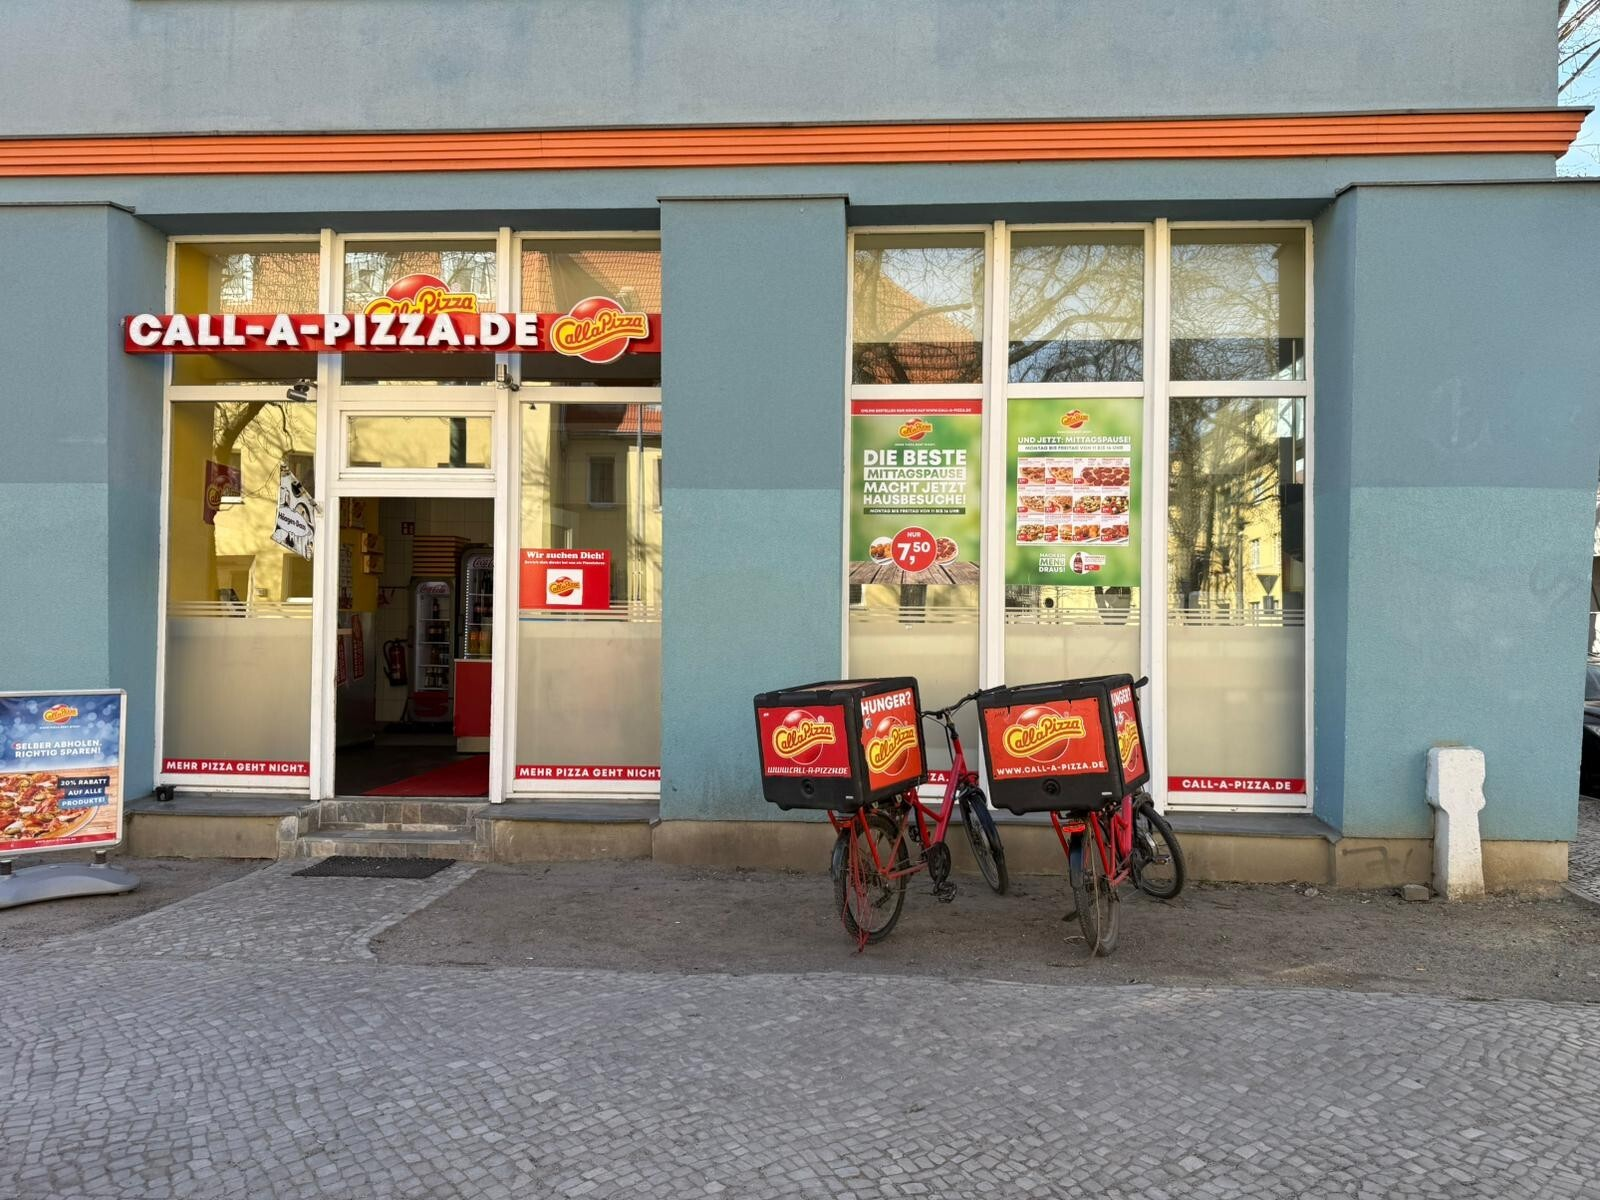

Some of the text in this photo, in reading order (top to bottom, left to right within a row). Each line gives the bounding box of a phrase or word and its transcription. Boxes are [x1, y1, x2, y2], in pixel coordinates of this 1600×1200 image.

[419, 289, 474, 315] Pizza
[129, 313, 539, 348] CALL-A-PIZZA.DE
[556, 321, 591, 351] Call
[598, 311, 643, 334] Pizza
[1065, 436, 1131, 444] MITTAGSPAUSE!
[864, 449, 967, 466] DIE BESTE
[867, 469, 963, 479] MITTAGSPAUSE
[864, 481, 967, 493] MACHT JETZT
[864, 494, 966, 505] HAUSBESUCHE!
[527, 551, 604, 560] Wir suchen Dich!
[897, 541, 931, 565] 7,50
[861, 691, 911, 716] HUNGER?
[776, 729, 798, 753] Call
[803, 720, 832, 744] Pizza
[1007, 727, 1038, 753] Call
[1042, 717, 1081, 738] Pizza
[15, 739, 102, 750] SELBER ABHOLEN.
[15, 747, 101, 758] RICHTIG SPAREN!
[166, 761, 308, 773] MEHR PIZZA GEHT NICHT.
[519, 768, 552, 777] MEHR
[556, 768, 589, 777] PIZZA
[593, 768, 623, 777] GEHT
[996, 760, 1105, 775] WWW.CALL-A-PIZZA.DE
[1182, 779, 1291, 790] CALL-A-PIZZA.DE
[62, 797, 106, 807] PRODUKTE!
